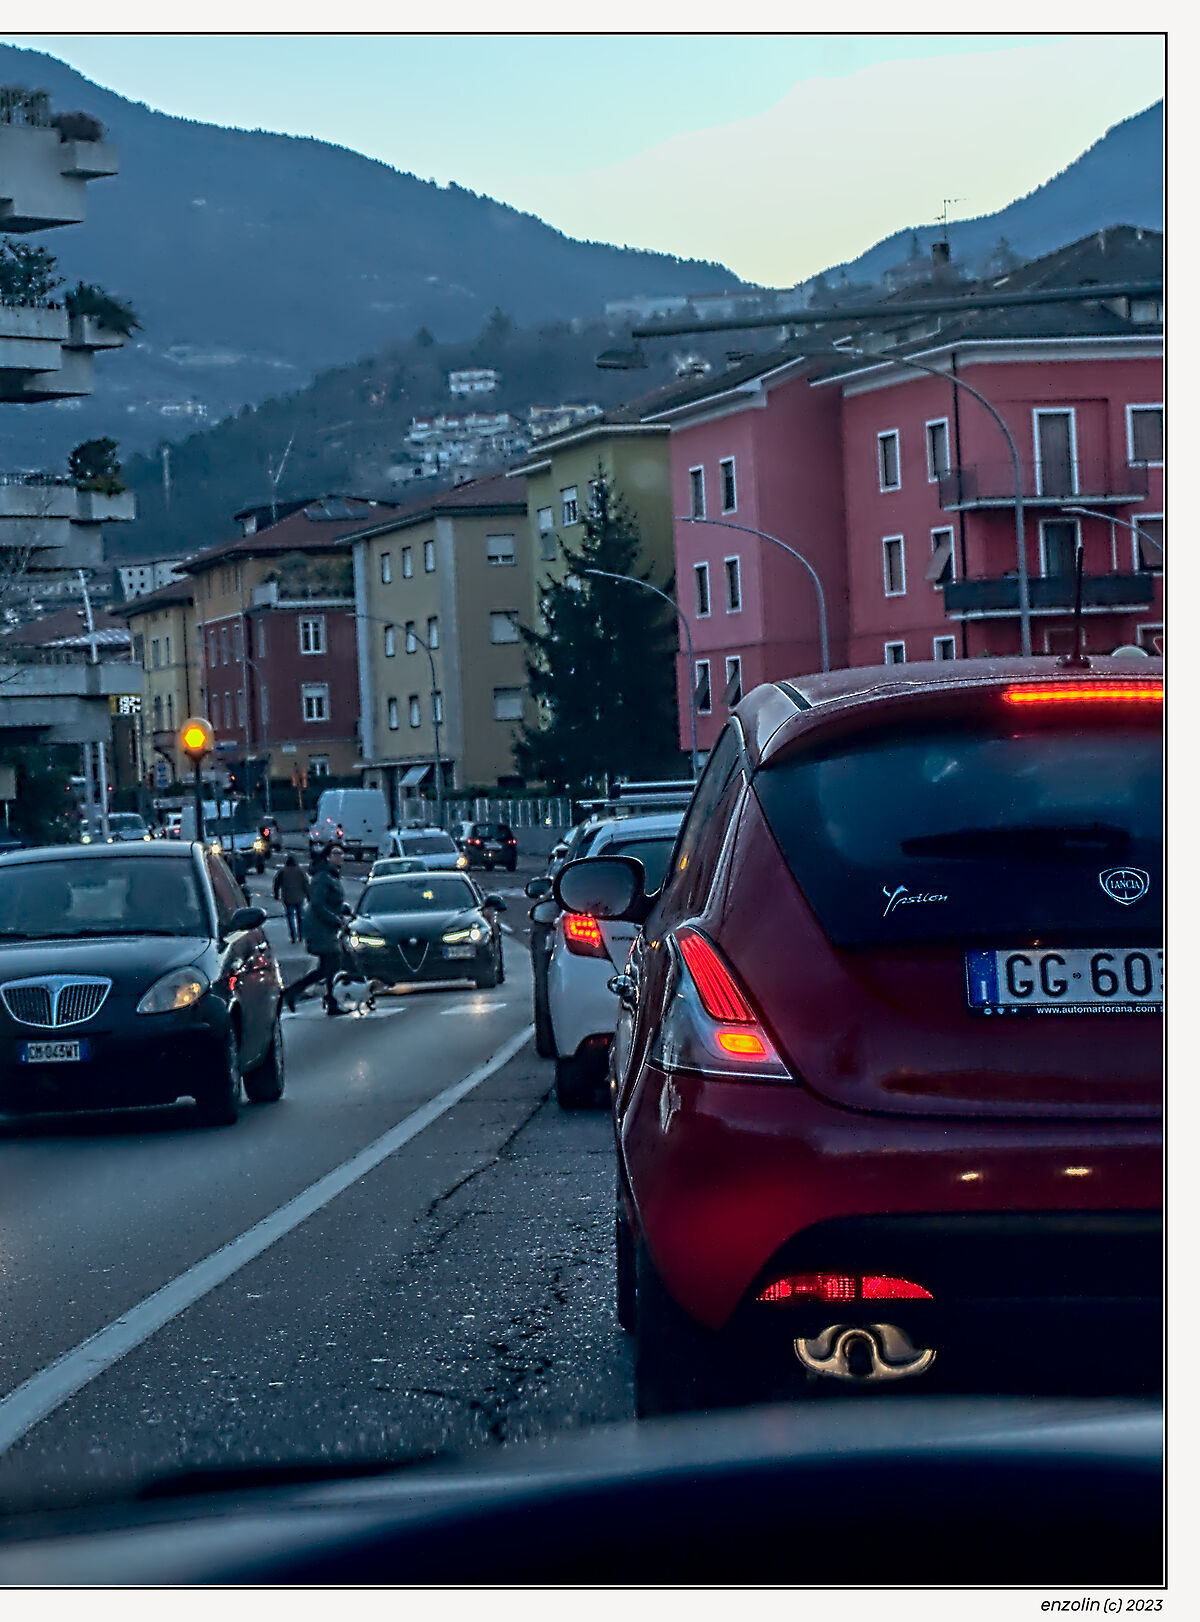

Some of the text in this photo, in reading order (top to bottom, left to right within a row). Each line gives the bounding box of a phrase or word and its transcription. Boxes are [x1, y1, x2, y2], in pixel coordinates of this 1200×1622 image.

[1110, 879, 1141, 889] LANCIA
[882, 884, 948, 917] Ypsilon
[1036, 1004, 1157, 1015] www.automartorana.com
